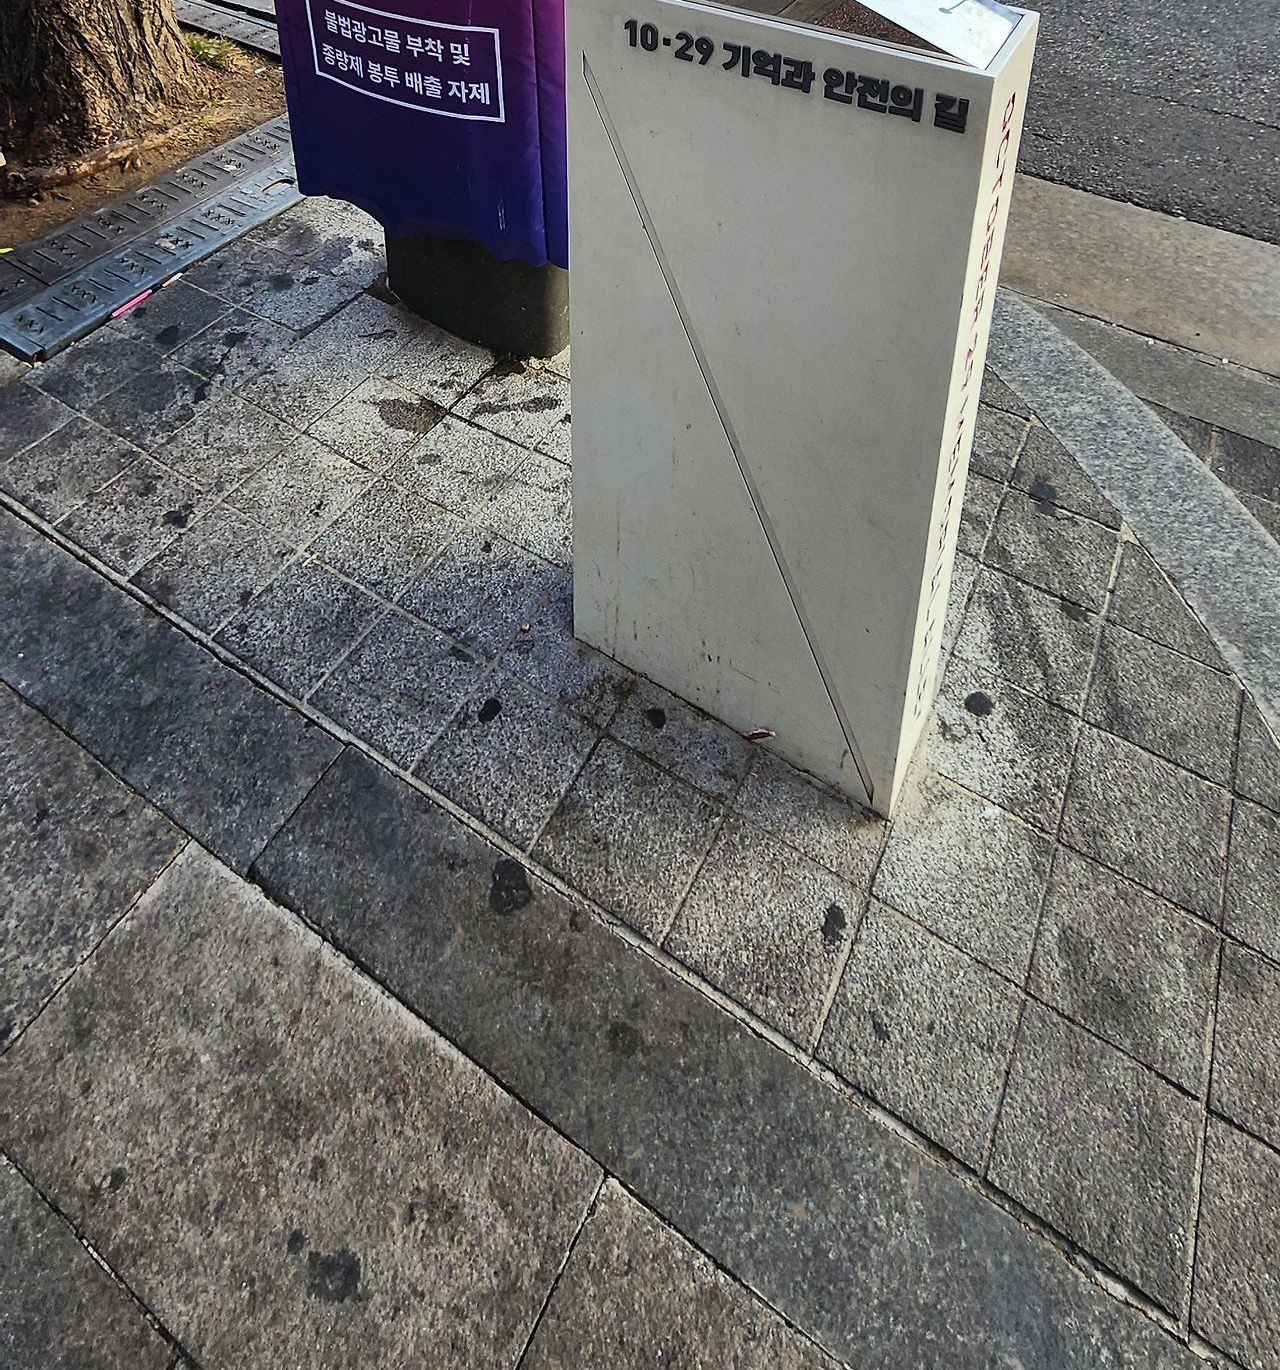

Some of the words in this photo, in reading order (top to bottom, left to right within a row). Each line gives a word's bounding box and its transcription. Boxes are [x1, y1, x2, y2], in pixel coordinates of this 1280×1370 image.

[322, 43, 363, 78] 종량제
[367, 60, 400, 88] 봉투
[405, 71, 442, 99] 배출
[448, 80, 491, 105] 자제
[324, 9, 401, 53] 불법광고물
[406, 34, 444, 62] 부착
[450, 42, 471, 66] 및
[624, 19, 714, 66] 10·29
[721, 41, 815, 94] 기억과
[822, 67, 924, 122] 안전의
[933, 92, 970, 134] 길
[970, 91, 1016, 332] OCTOBER
